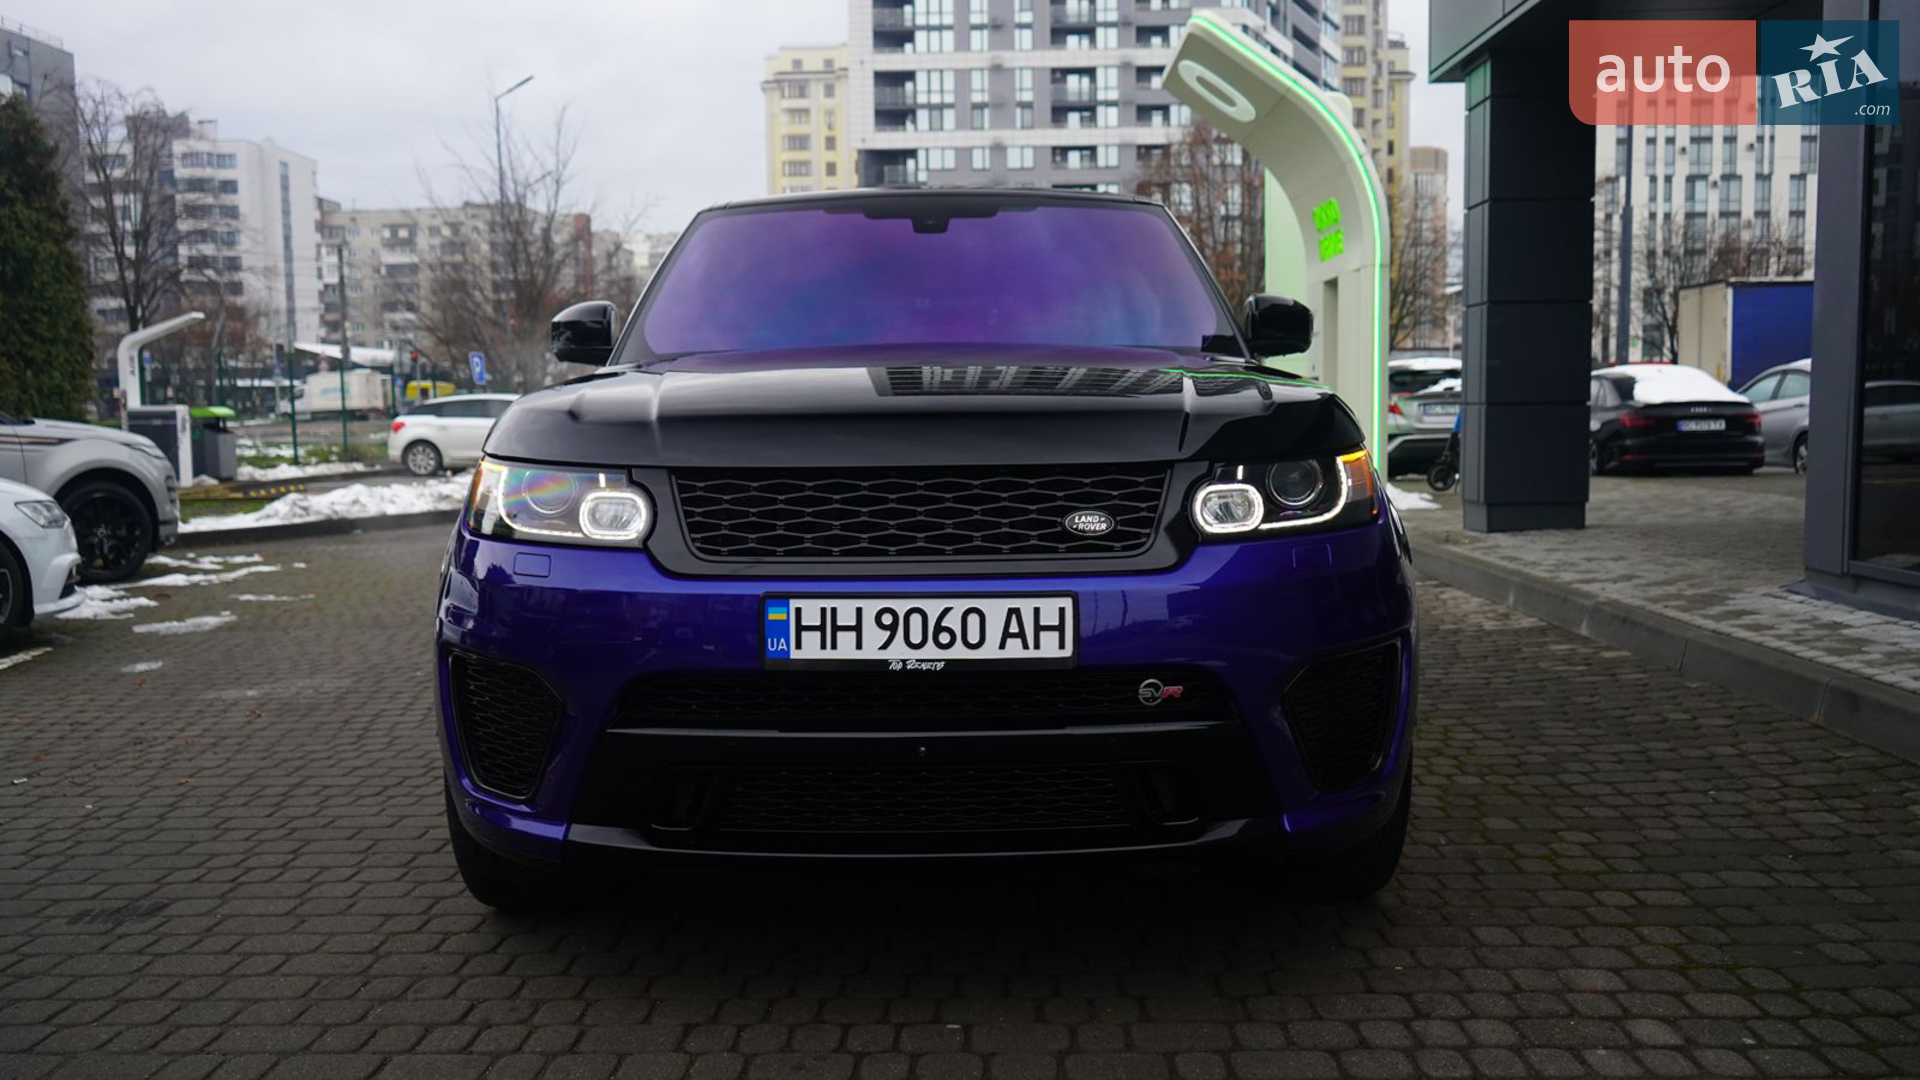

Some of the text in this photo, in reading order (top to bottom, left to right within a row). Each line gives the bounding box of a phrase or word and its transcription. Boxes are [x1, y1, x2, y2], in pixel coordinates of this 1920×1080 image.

[794, 606, 1066, 651] HH 9060 AH
[768, 637, 788, 651] UA
[1139, 684, 1184, 700] SVR
